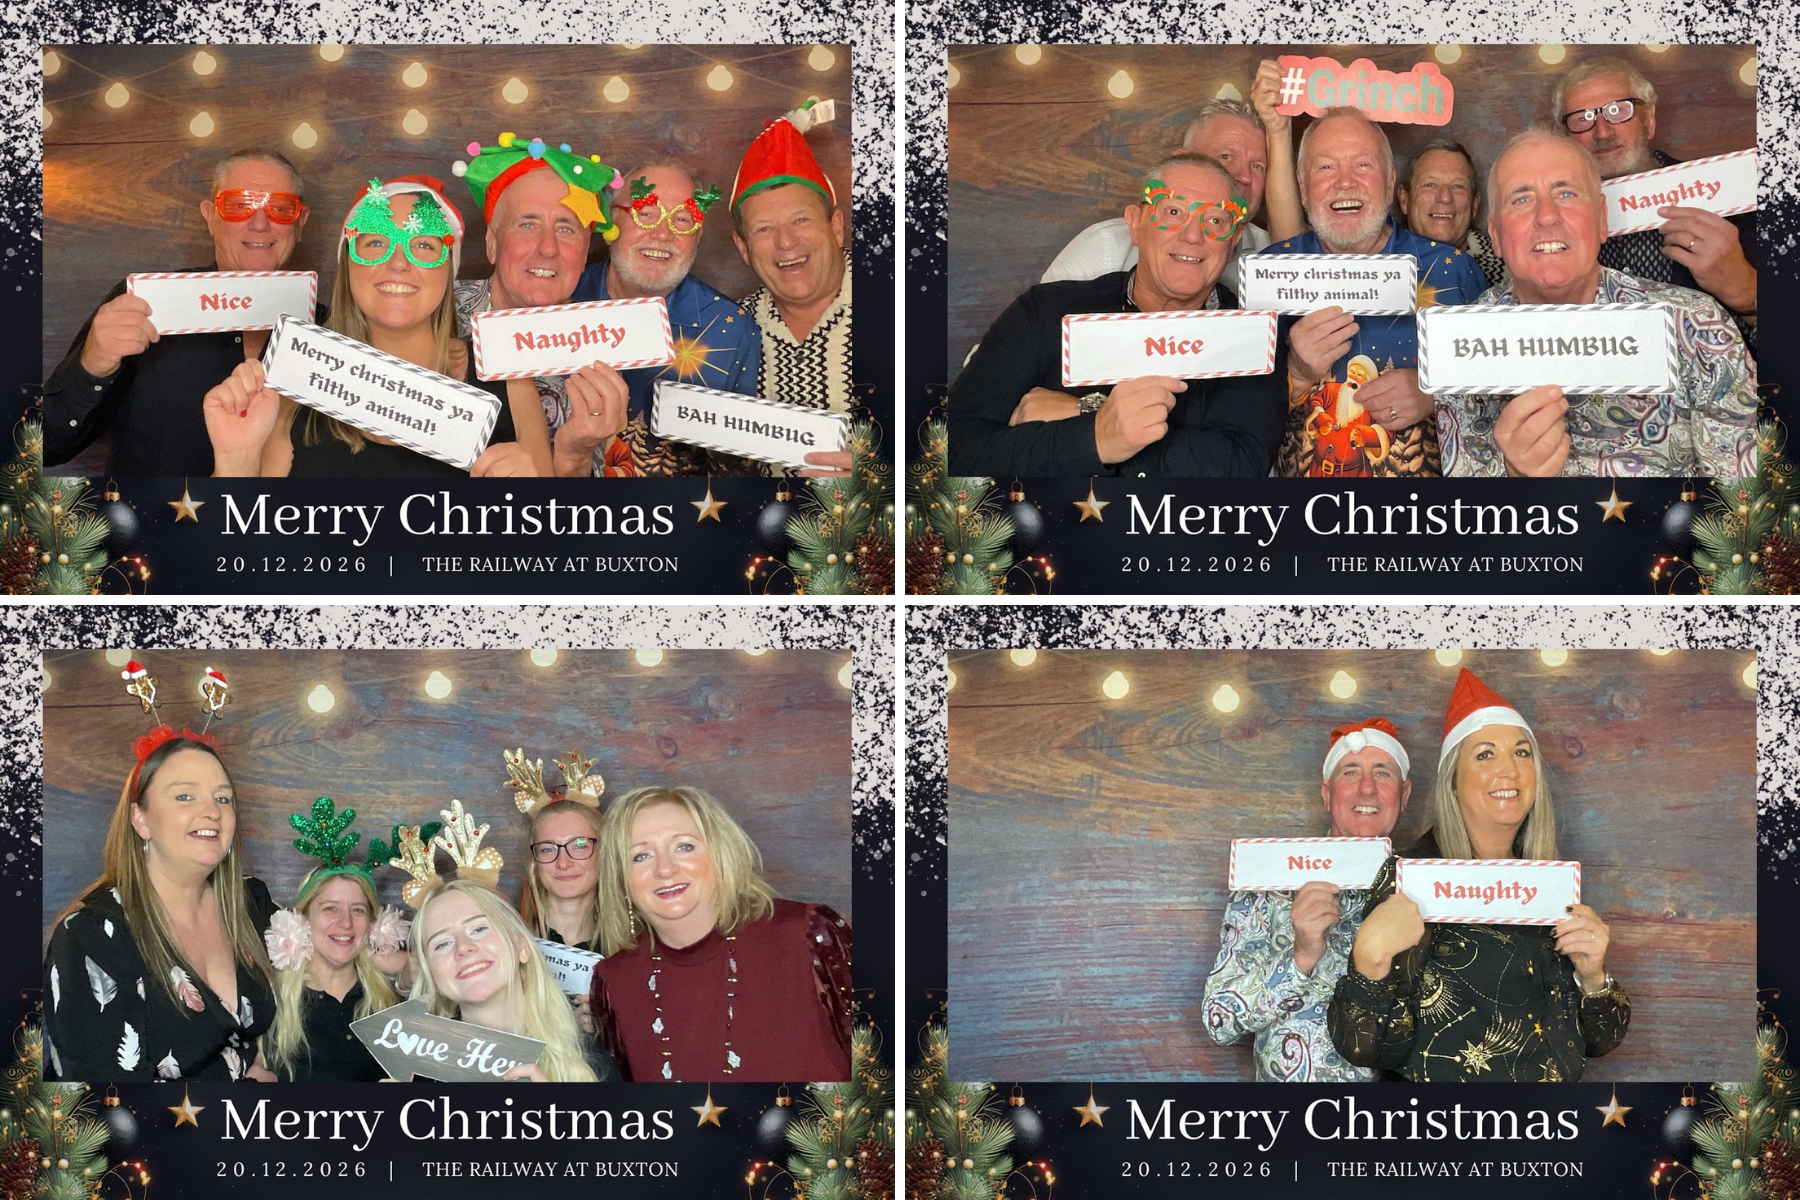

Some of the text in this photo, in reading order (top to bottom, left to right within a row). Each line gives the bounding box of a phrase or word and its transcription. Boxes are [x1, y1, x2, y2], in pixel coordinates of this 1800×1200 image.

[1279, 67, 1444, 114] #Grinch
[1618, 179, 1721, 213] Naughty
[1255, 267, 1402, 283] Merry christmas ya
[199, 293, 253, 311] Nice
[1323, 287, 1379, 301] animal!
[513, 323, 626, 353] Naughty
[1143, 335, 1205, 357] Nice
[1452, 335, 1640, 361] BAH HUMBUG
[290, 337, 475, 422] Merry christmas ya
[365, 400, 438, 436] animal!
[677, 405, 816, 447] BAH HUMBUG
[1286, 855, 1333, 871] Nice
[1433, 880, 1538, 906] Naughty
[572, 962, 590, 972] ya
